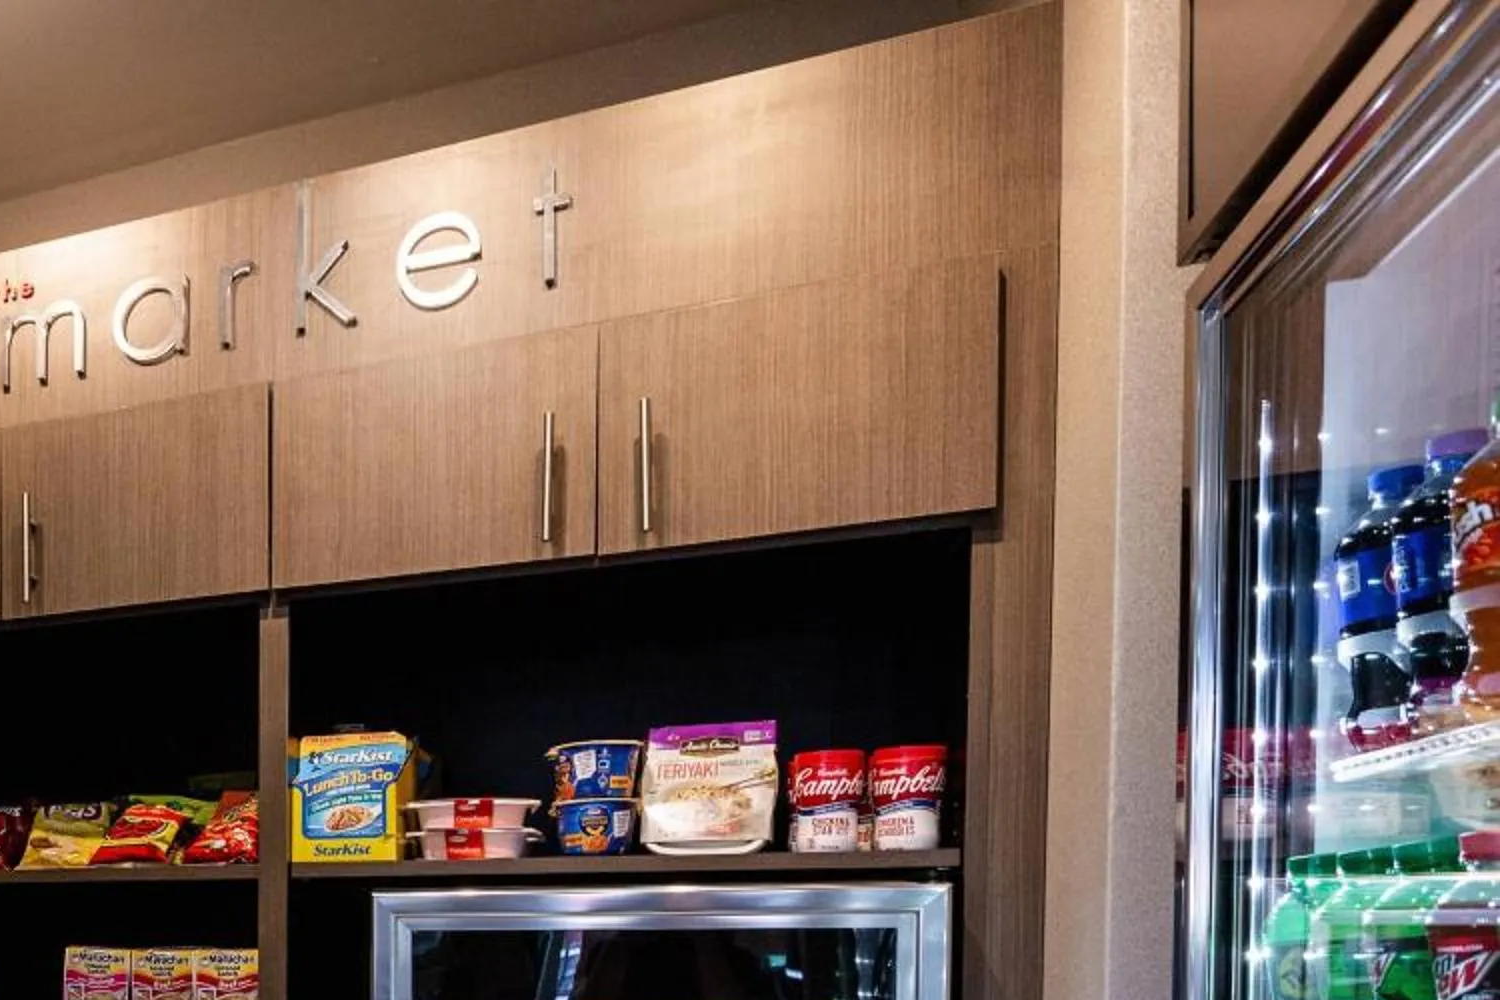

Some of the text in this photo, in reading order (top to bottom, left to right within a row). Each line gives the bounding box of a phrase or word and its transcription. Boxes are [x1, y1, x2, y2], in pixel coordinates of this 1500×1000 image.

[1, 166, 573, 394] market
[322, 749, 393, 765] StarKist
[656, 760, 719, 780] TERIYAKI
[304, 772, 348, 797] Lunch
[795, 767, 864, 800] Campb
[312, 843, 372, 857] StarKist
